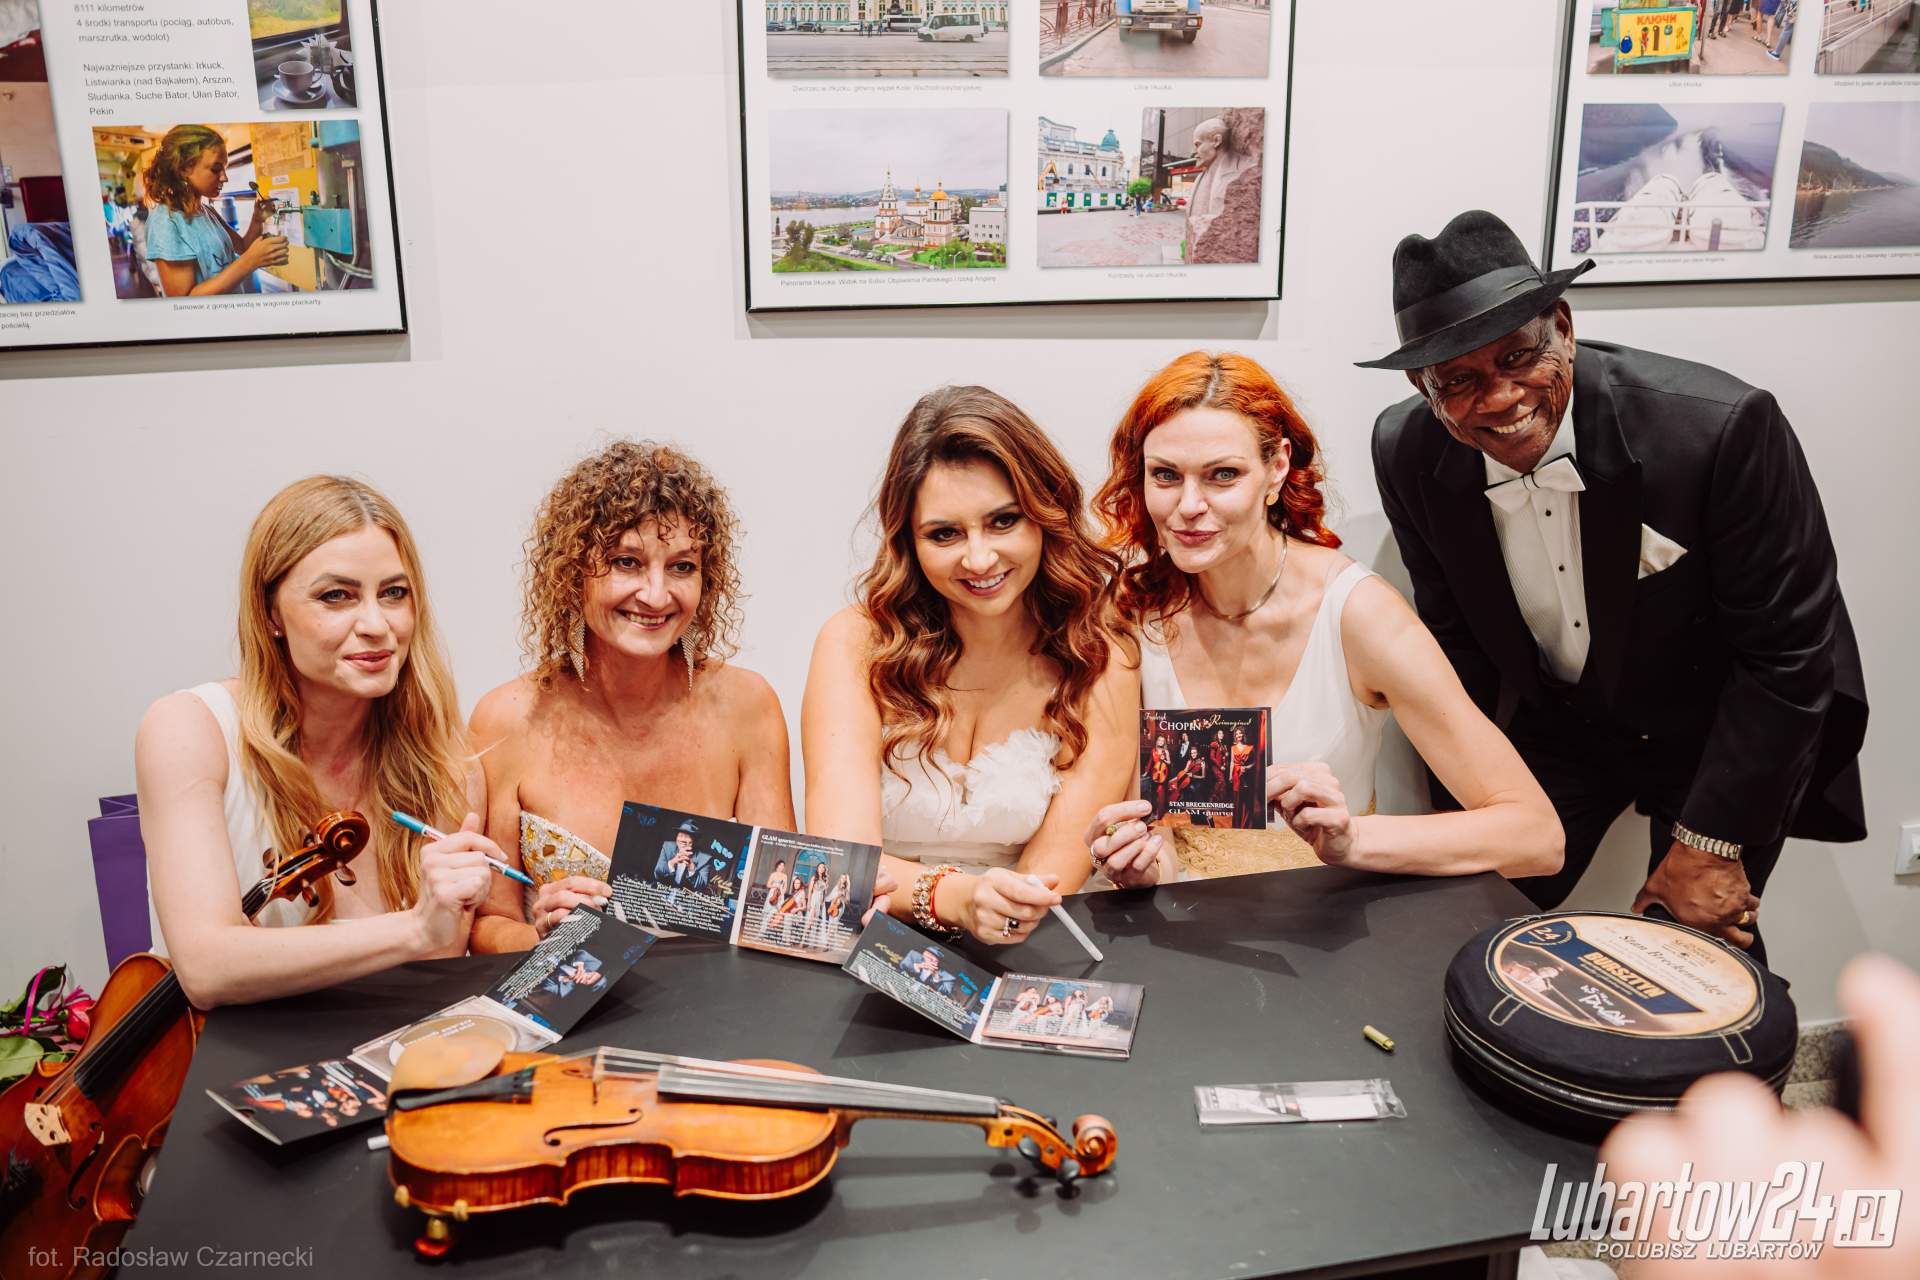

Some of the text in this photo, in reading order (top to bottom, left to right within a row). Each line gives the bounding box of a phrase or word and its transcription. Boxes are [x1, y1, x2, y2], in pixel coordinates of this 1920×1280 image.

[97, 3, 144, 12] kilometrów
[113, 18, 158, 28] transportu
[160, 18, 195, 28] (pociąg,
[197, 17, 234, 26] autobus,
[1636, 14, 1677, 26] КЛЮЧИ
[79, 34, 130, 42] marszrutka,
[83, 61, 224, 74] Najważniejsze przystanki: Irkuck,
[85, 78, 131, 87] Listwianka
[133, 77, 153, 87] (nad
[202, 75, 234, 84] Arszan,
[135, 92, 162, 101] Suche
[165, 91, 190, 101] Bator,
[214, 89, 239, 99] Bator,
[89, 107, 114, 117] Pekin
[1159, 720, 1201, 731] CHOPIN
[1582, 951, 1667, 998] BURSZTYN
